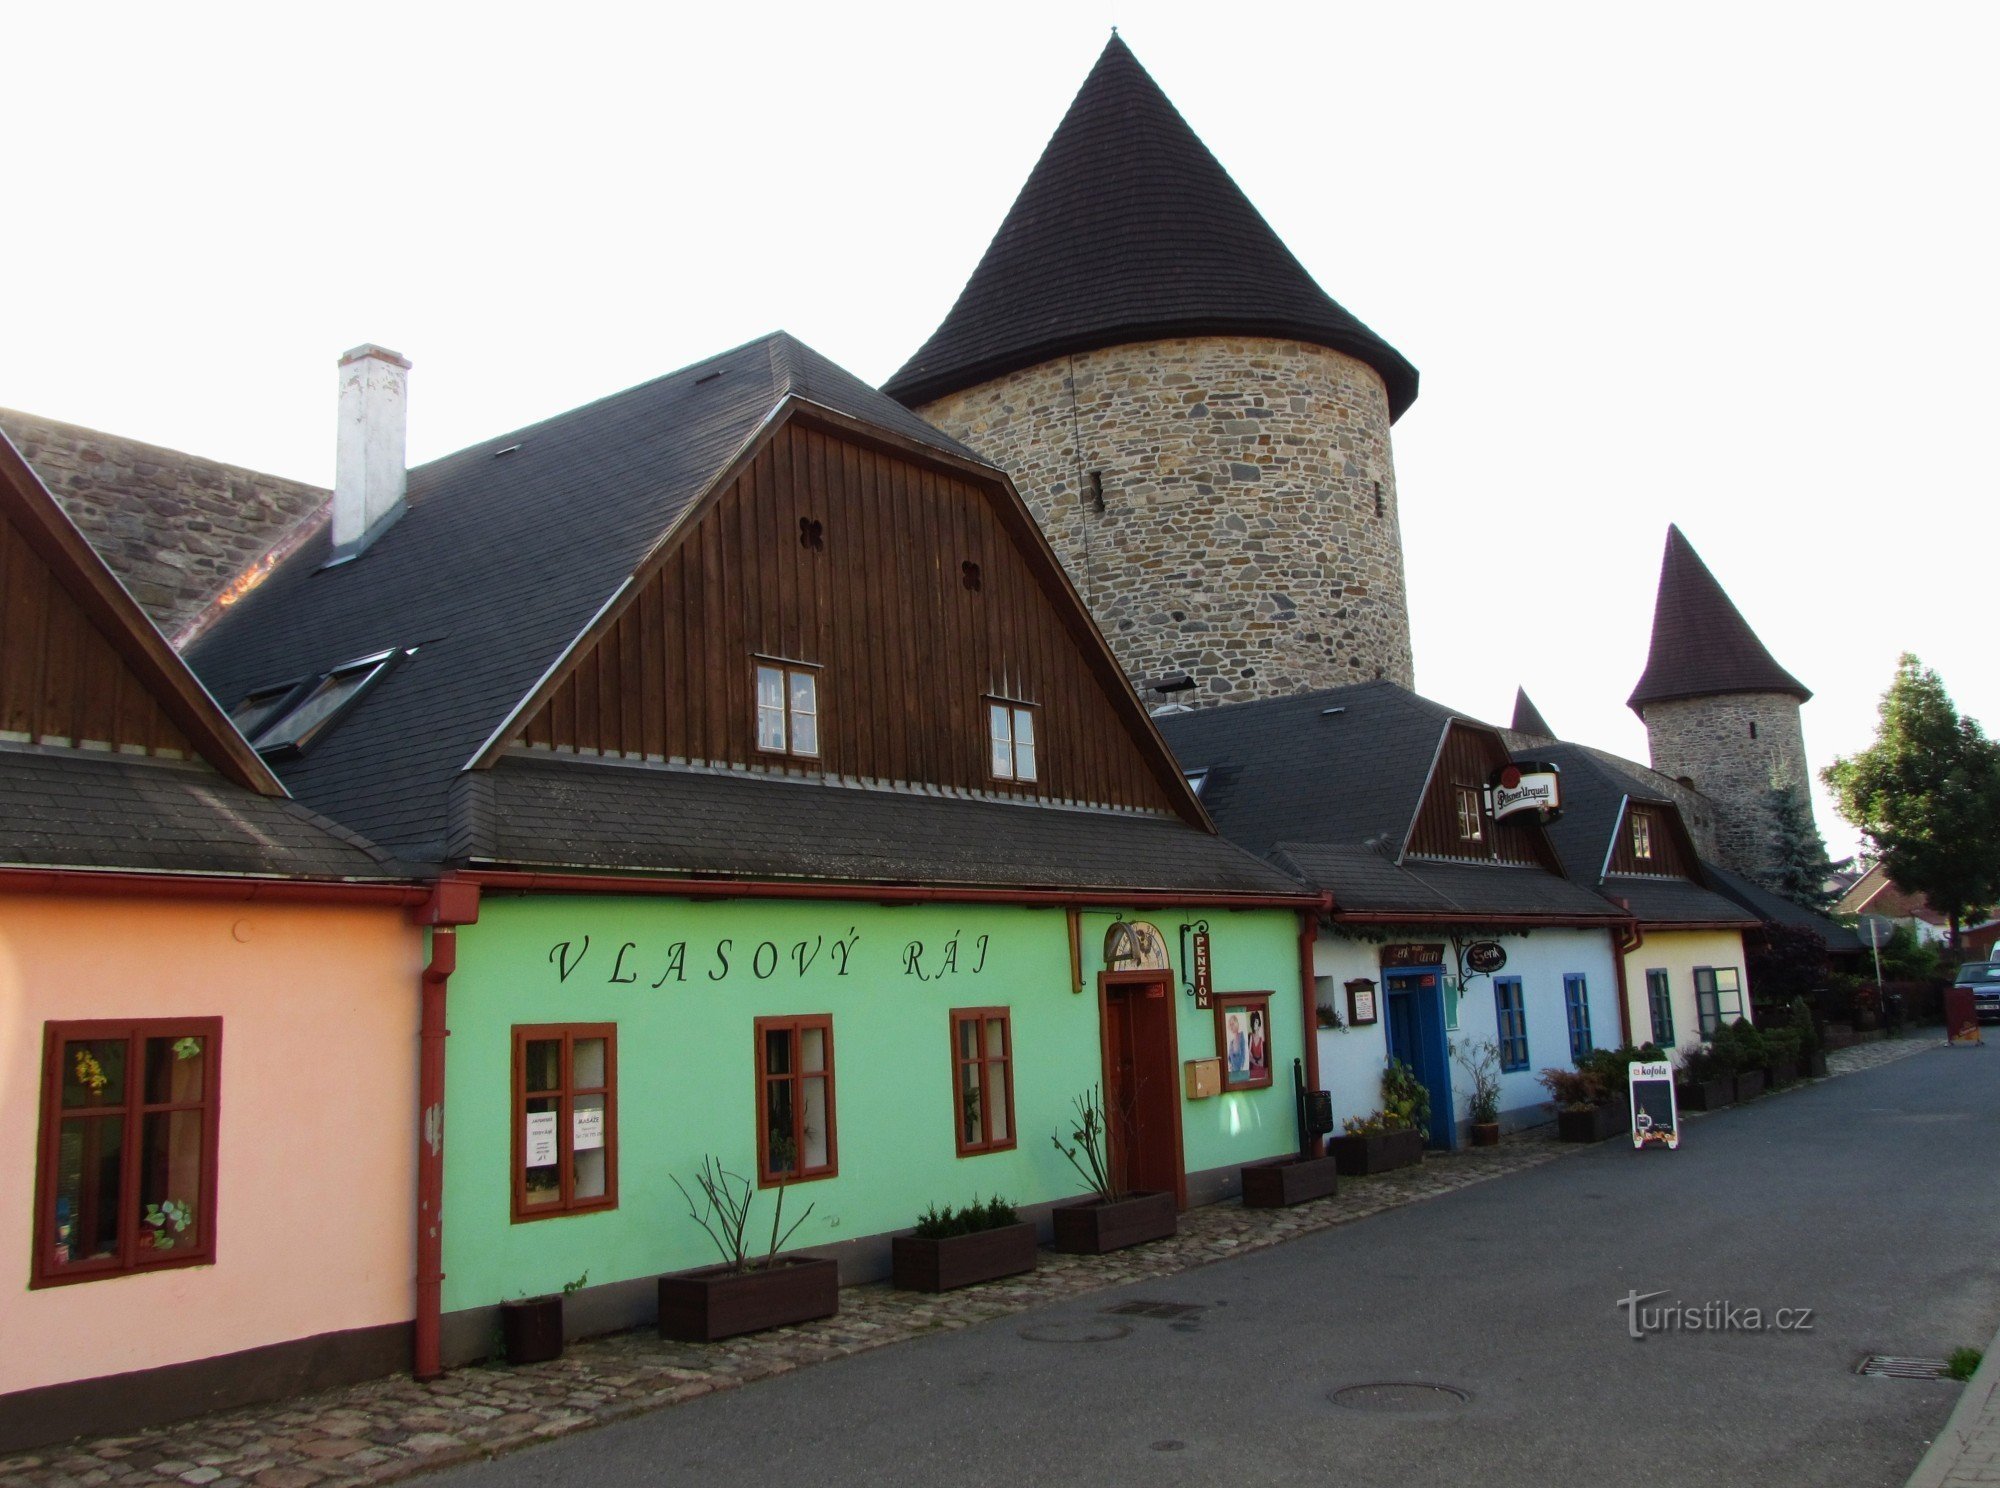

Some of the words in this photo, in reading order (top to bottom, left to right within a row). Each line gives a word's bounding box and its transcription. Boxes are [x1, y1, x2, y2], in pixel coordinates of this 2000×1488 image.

[1497, 790, 1521, 809] Pilsner
[1521, 785, 1548, 799] Urquell
[548, 927, 860, 988] VLASOVÝ
[902, 929, 989, 981] RÁJ
[1196, 937, 1207, 1005] PENZION
[1641, 1066, 1667, 1076] kofola
